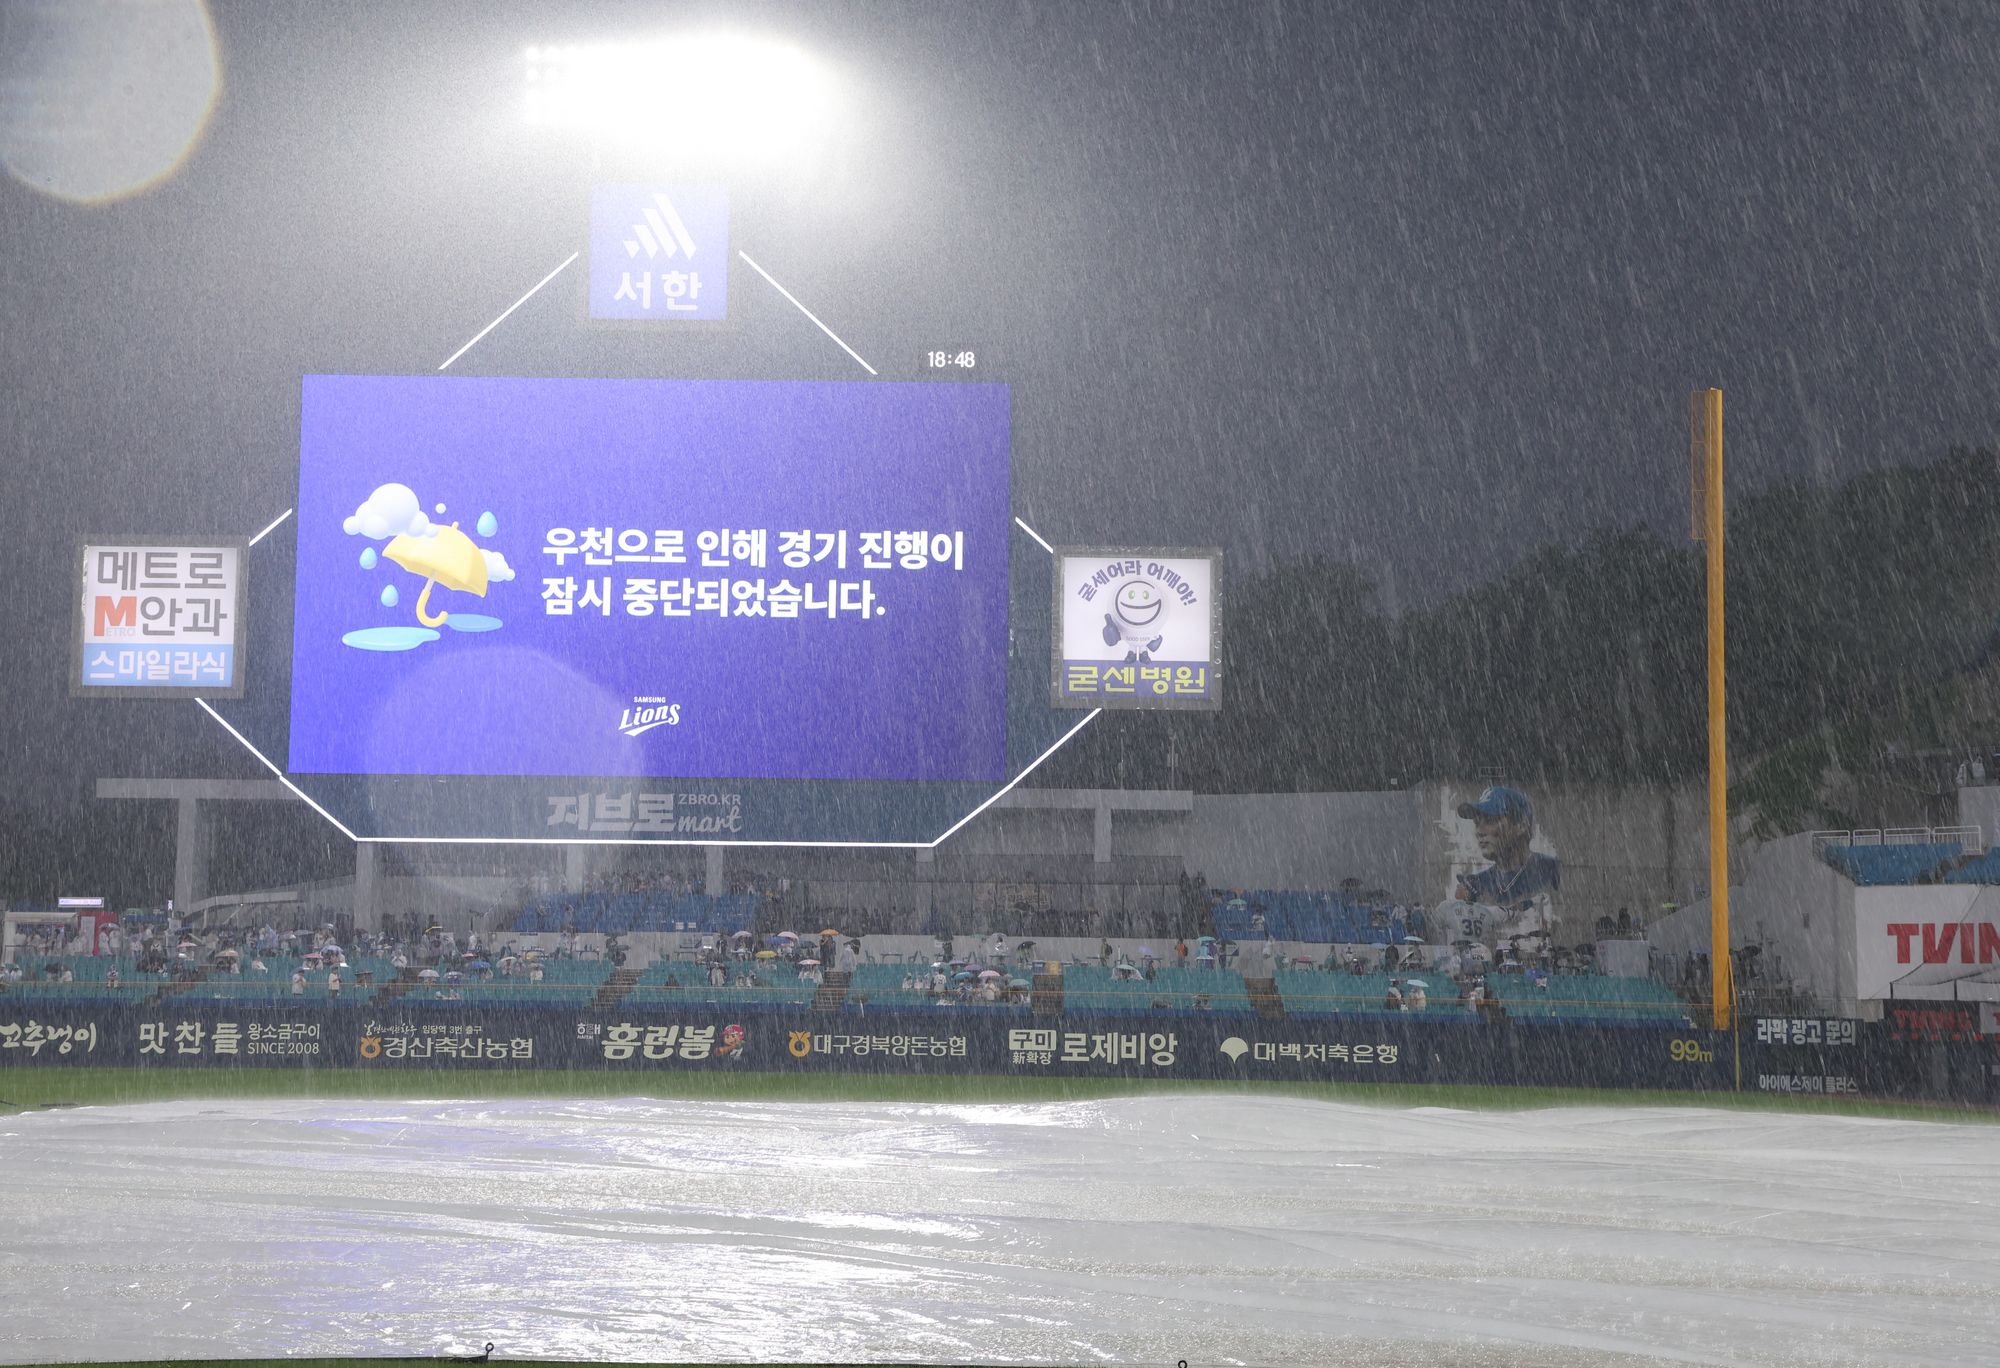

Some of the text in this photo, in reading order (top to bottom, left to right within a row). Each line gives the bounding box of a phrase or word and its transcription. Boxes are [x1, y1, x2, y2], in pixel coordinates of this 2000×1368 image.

[613, 270, 703, 311] 서한
[927, 351, 976, 368] 18:48
[542, 528, 964, 571] 우천으로 인해 경기 진행이
[97, 551, 226, 591] 메트로
[540, 576, 886, 618] 잠시 중단되었습니다.
[140, 597, 228, 637] 안과
[89, 650, 226, 681] 스마일라식
[618, 704, 681, 737] Lions
[547, 792, 676, 832] 지브로
[678, 794, 741, 805] ZBRO.KR
[678, 806, 742, 833] mart
[247, 1023, 320, 1040] 왕소금구이
[601, 1022, 715, 1060] 홈런볼
[813, 1034, 967, 1057] 대구경북양돈농협
[1791, 1019, 1822, 1045] 광고
[1826, 1020, 1857, 1046] 문의
[247, 1042, 320, 1054] SINCE 2008
[383, 1037, 533, 1059] 경산축산농협
[1060, 1031, 1178, 1066] 로제비앙
[1254, 1042, 1398, 1064] 대백저축은행
[1670, 1039, 1713, 1063] 99m
